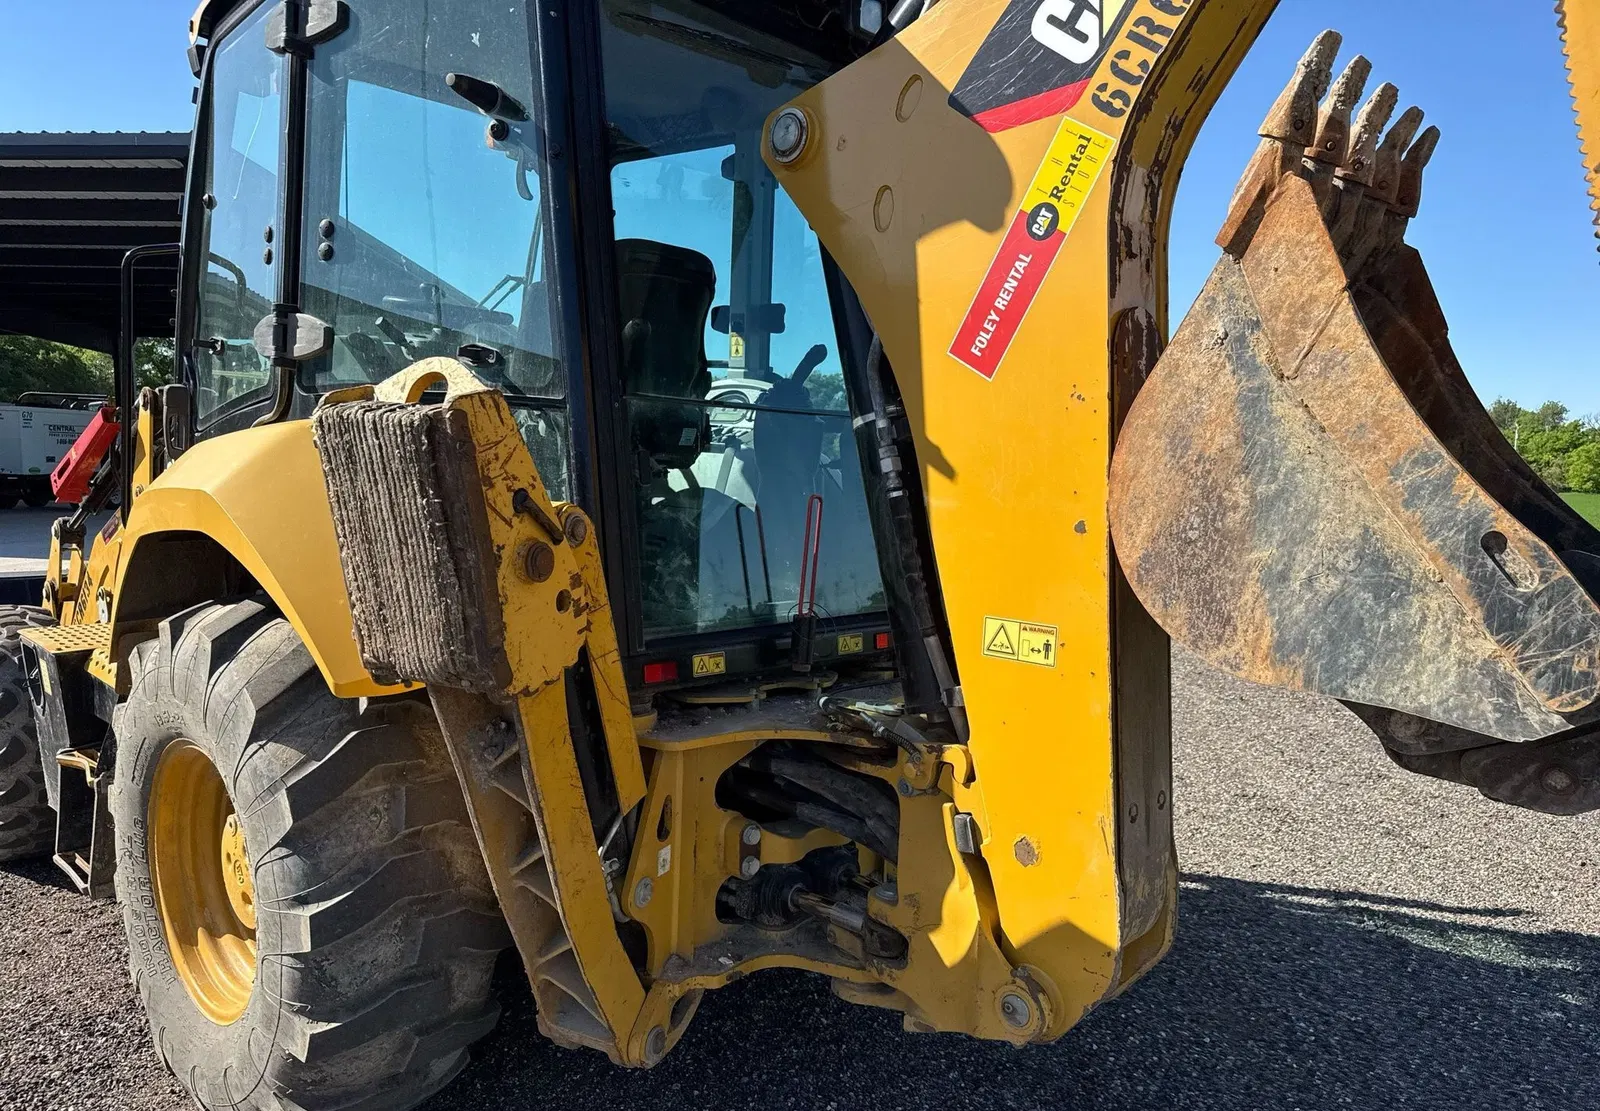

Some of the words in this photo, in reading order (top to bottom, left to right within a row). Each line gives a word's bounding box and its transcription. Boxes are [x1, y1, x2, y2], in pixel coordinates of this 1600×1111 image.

[1032, 207, 1053, 236] CAT
[1049, 134, 1092, 203] Rental
[1063, 140, 1105, 208] STORE
[971, 309, 1000, 357] FOLEY
[994, 253, 1032, 311] RENTAL
[1028, 627, 1055, 636] WARNING
[133, 816, 147, 865] LUG
[138, 876, 177, 991] TRACTOR
